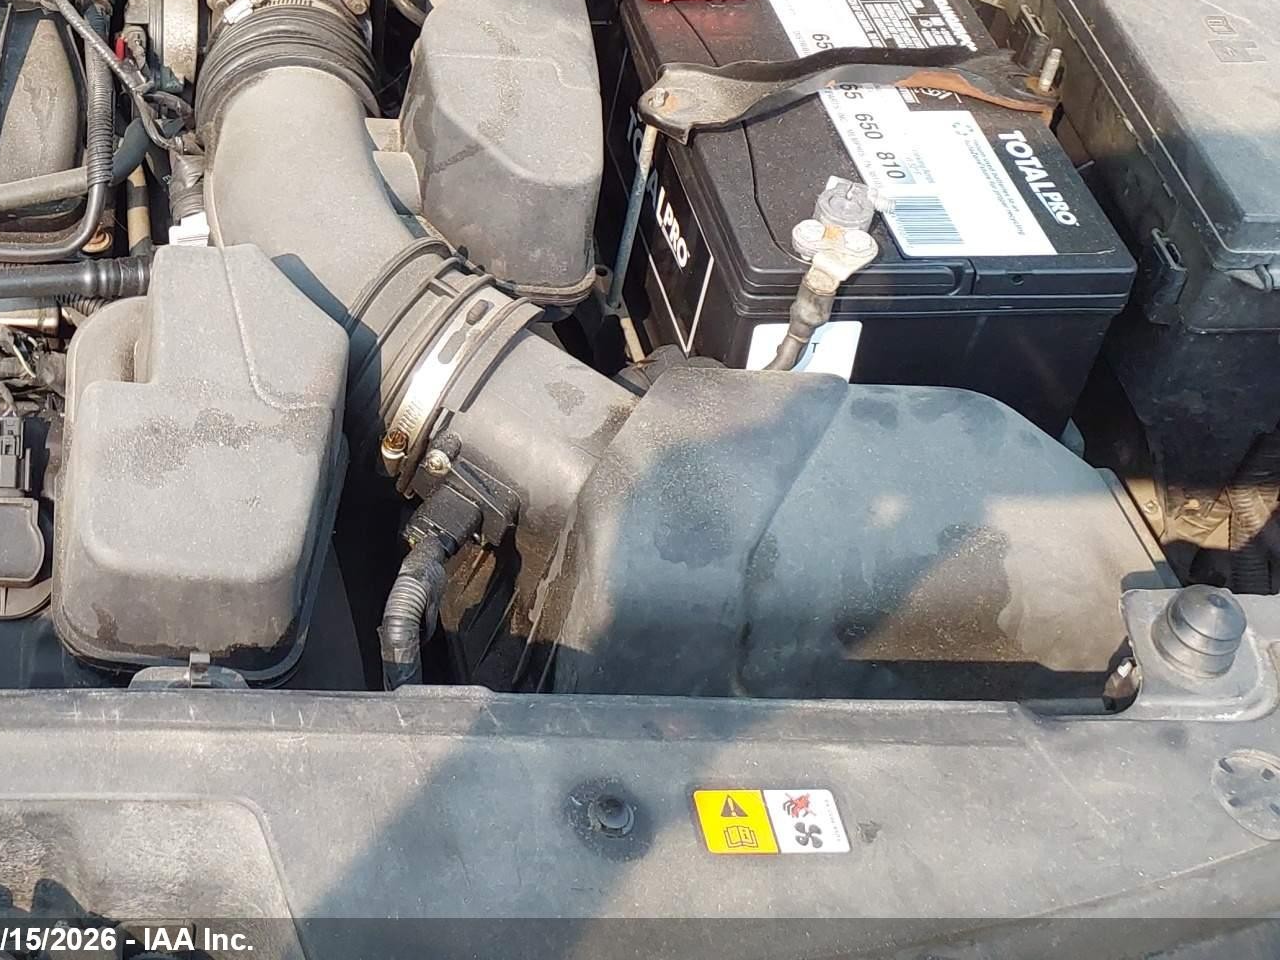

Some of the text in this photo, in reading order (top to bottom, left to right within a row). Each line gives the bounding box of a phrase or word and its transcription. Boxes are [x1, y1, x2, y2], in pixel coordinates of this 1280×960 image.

[854, 113, 884, 140] 650
[876, 151, 907, 179] 810
[998, 129, 1080, 227] TOTALPRO
